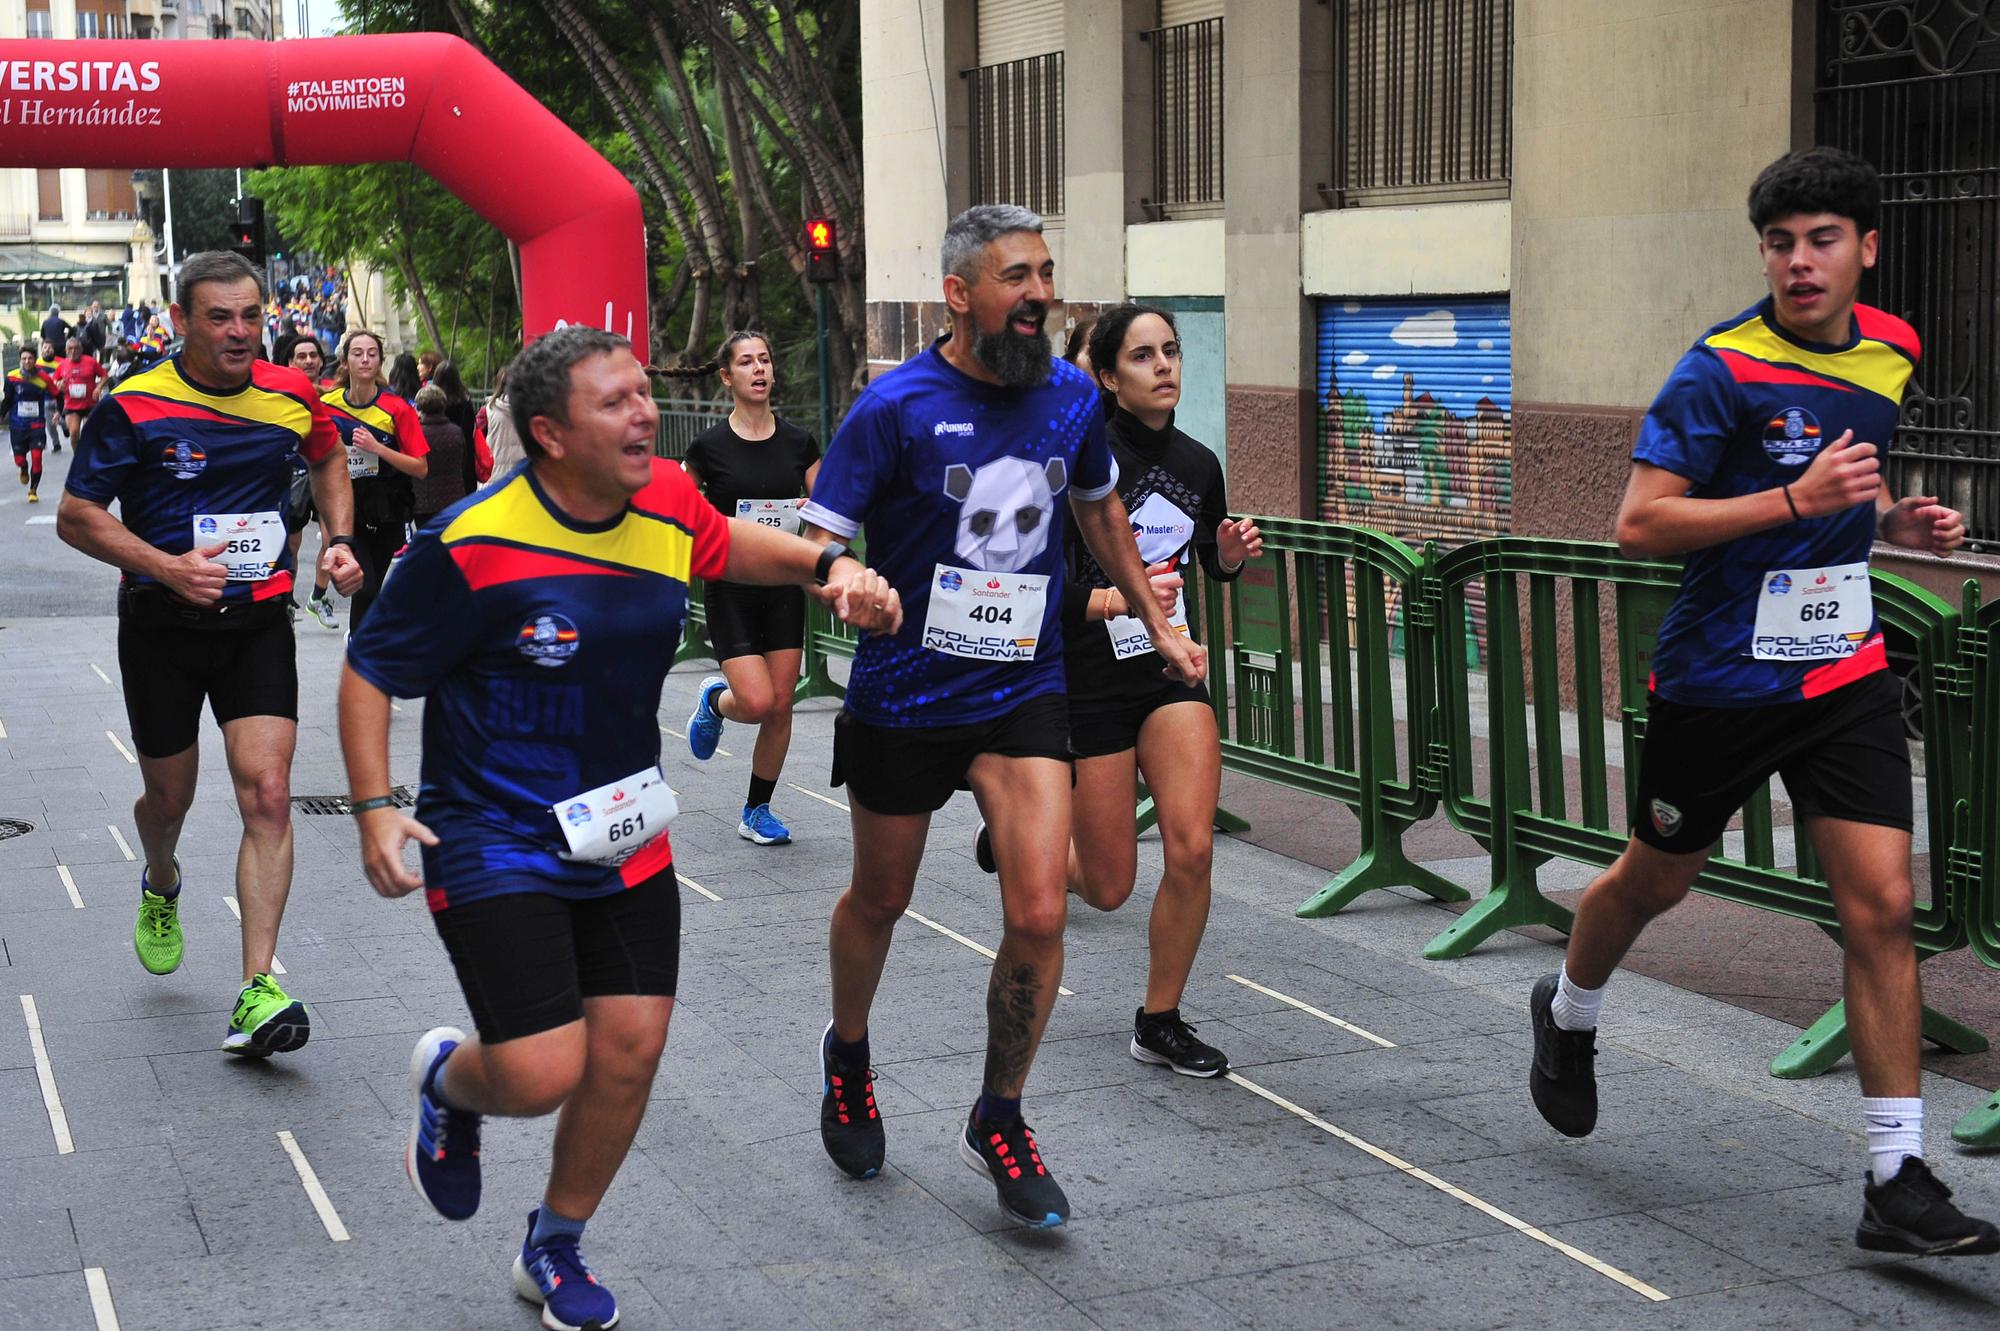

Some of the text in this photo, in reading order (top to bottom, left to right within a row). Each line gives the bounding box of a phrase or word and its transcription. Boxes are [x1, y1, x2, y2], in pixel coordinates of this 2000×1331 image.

[287, 77, 405, 97] #TALENTOEN
[287, 92, 406, 112] MOVIMIENTO
[18, 99, 161, 126] Hernández
[227, 539, 262, 553] 562
[972, 588, 1011, 599] Santander
[969, 605, 1013, 625] 404
[1801, 601, 1840, 622] 662
[925, 636, 1034, 658] NACIONAL
[927, 626, 1018, 648] POLICIA
[1756, 632, 1848, 646] POLICIA
[608, 811, 645, 843] 661
